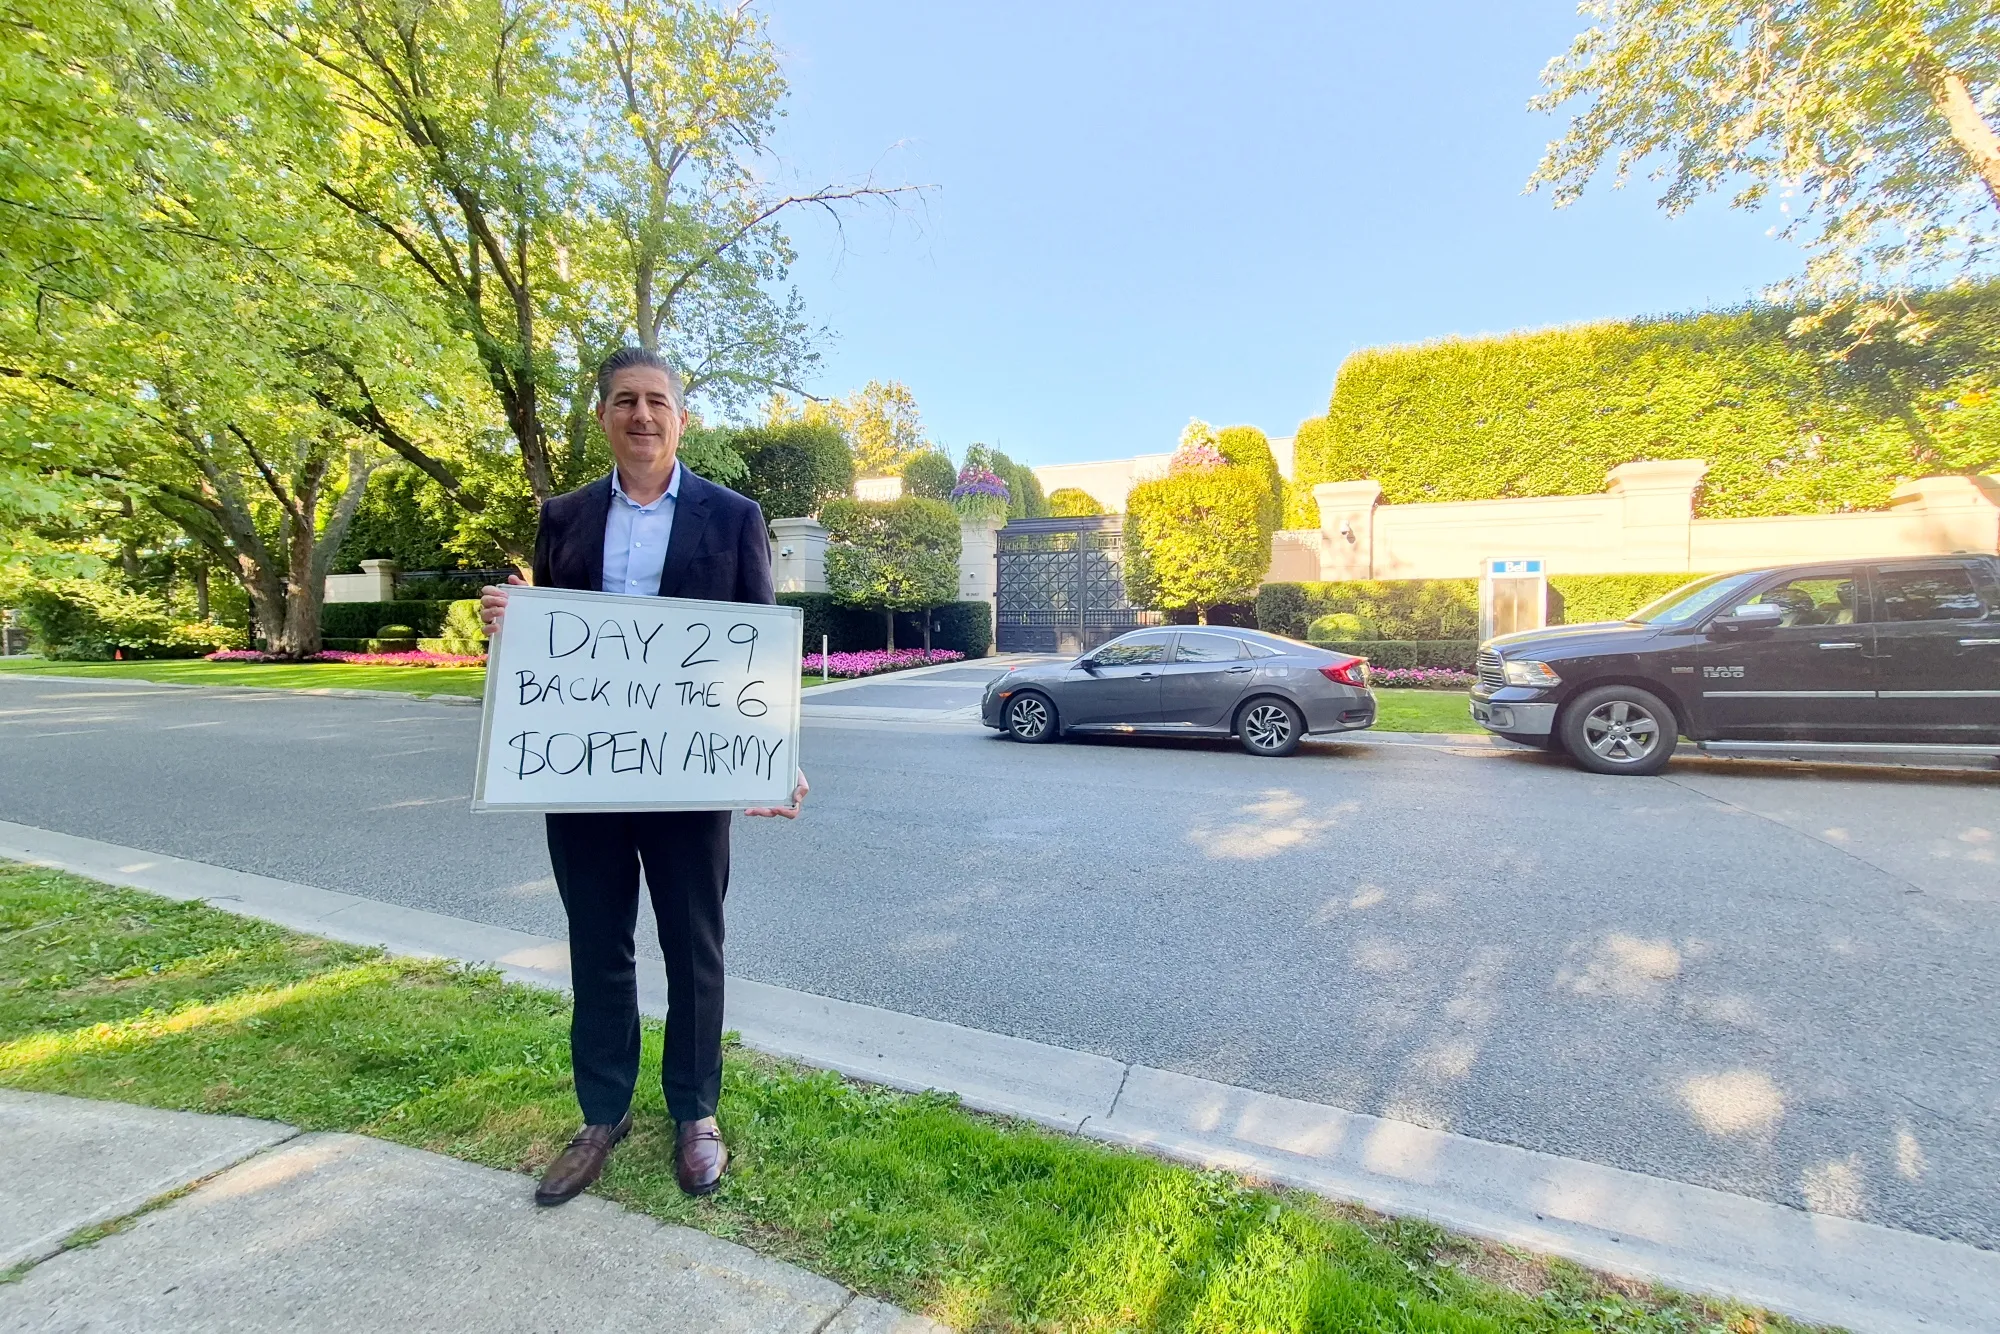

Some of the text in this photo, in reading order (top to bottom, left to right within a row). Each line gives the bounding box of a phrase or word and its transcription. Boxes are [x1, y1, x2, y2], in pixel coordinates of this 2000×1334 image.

[1505, 561, 1527, 572] Bell
[545, 611, 759, 673] DAY 29
[515, 669, 768, 718] BACK IN THE 6
[503, 730, 784, 780] $OPEN ARMY
